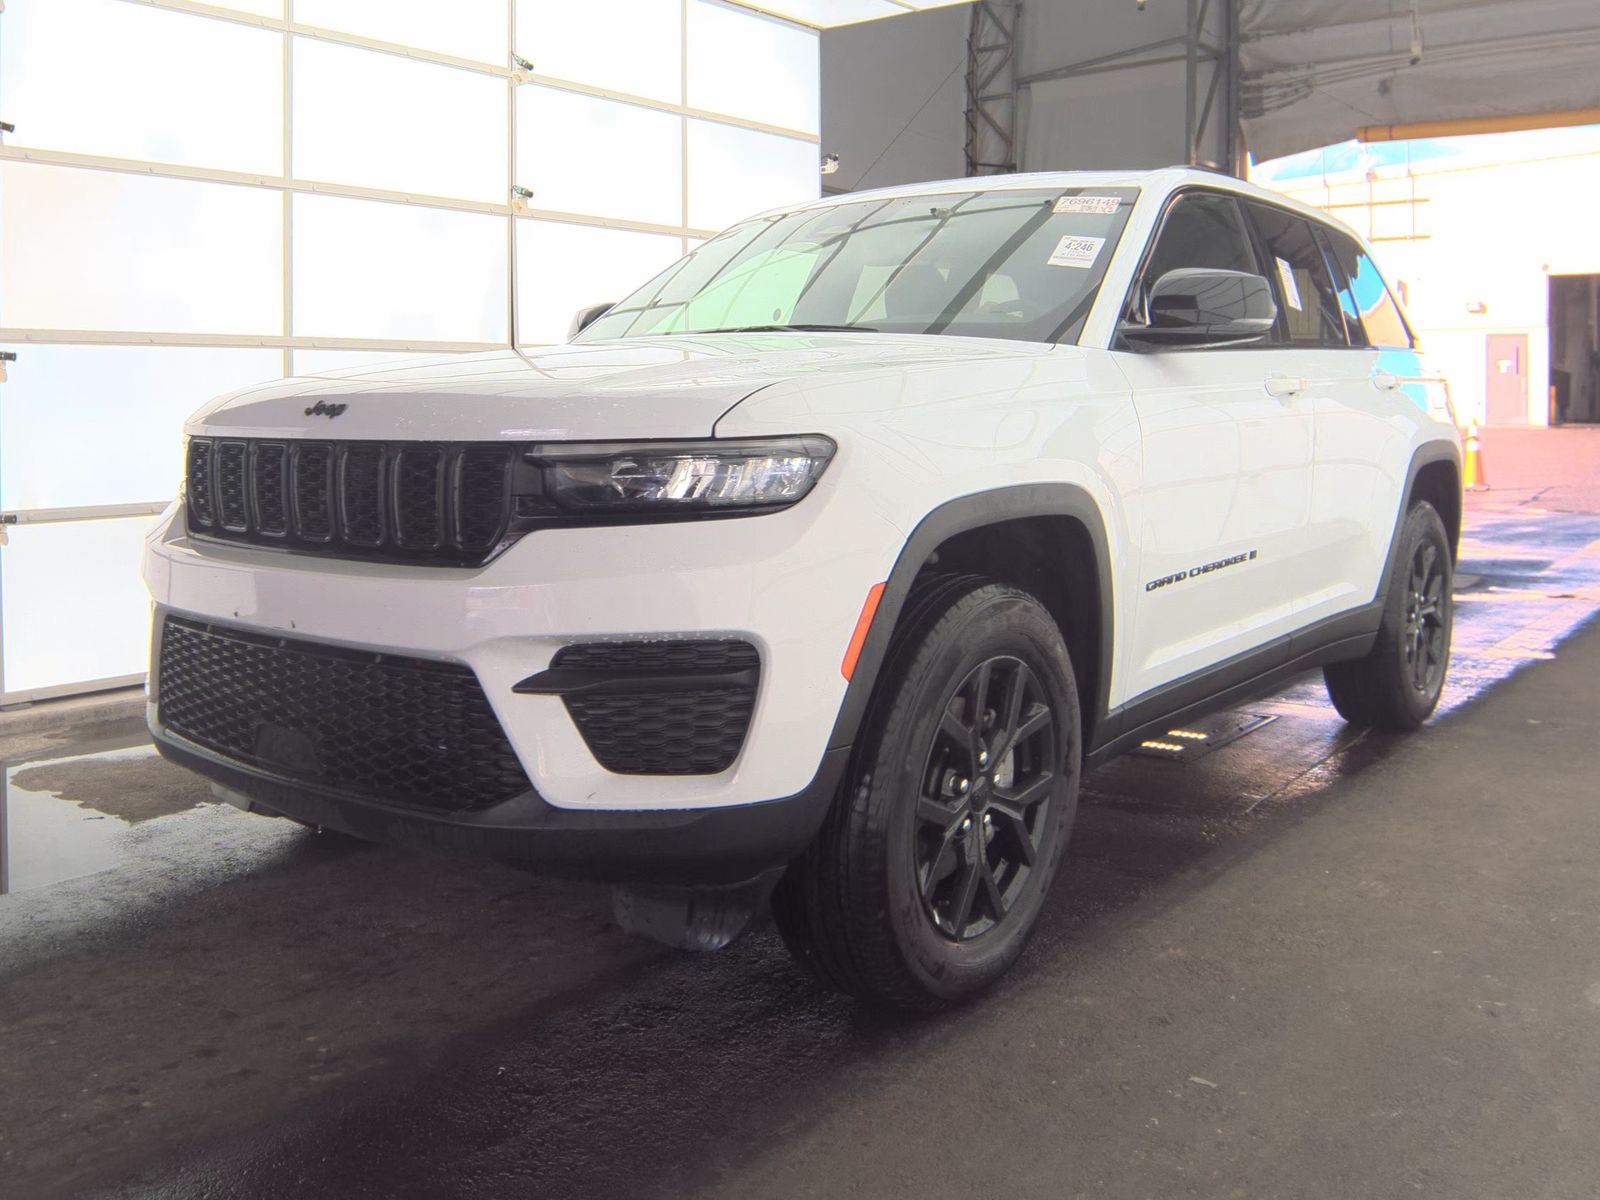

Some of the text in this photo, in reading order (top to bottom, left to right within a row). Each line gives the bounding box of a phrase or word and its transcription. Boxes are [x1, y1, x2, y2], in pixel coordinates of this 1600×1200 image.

[304, 400, 347, 419] Jeep
[1145, 553, 1247, 592] GRAND CHEROKEE
